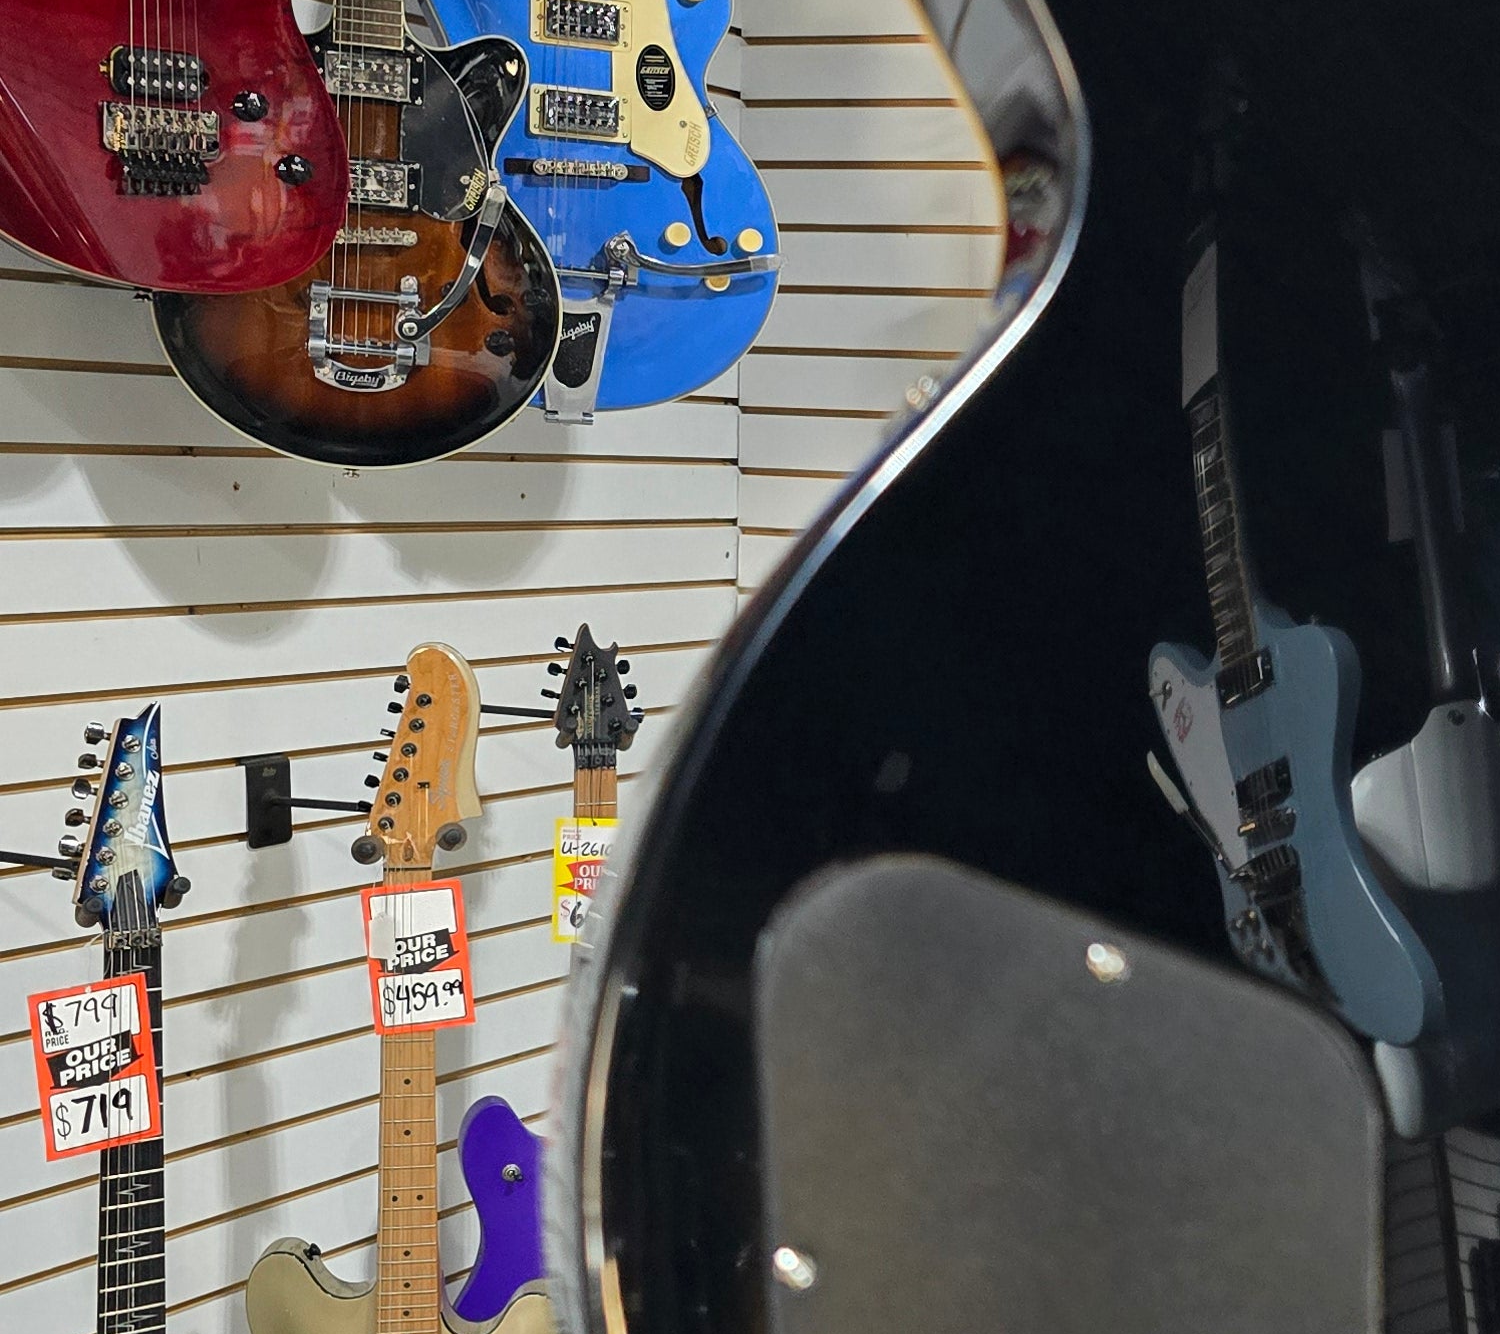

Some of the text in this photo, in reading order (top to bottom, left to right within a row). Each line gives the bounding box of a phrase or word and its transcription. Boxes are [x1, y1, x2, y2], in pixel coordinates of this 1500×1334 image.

[683, 121, 703, 168] GRETSCH
[560, 315, 596, 341] igsby
[334, 370, 383, 388] Bigsby
[124, 769, 160, 849] Ibanez
[387, 943, 449, 971] PRICE
[395, 933, 436, 956] OUR
[42, 993, 118, 1035] $799
[382, 978, 464, 1018] $459.99
[45, 1037, 70, 1048] PRICE
[65, 1037, 117, 1067] OUR
[59, 1048, 132, 1087] PRICE
[55, 1087, 134, 1141] $719
